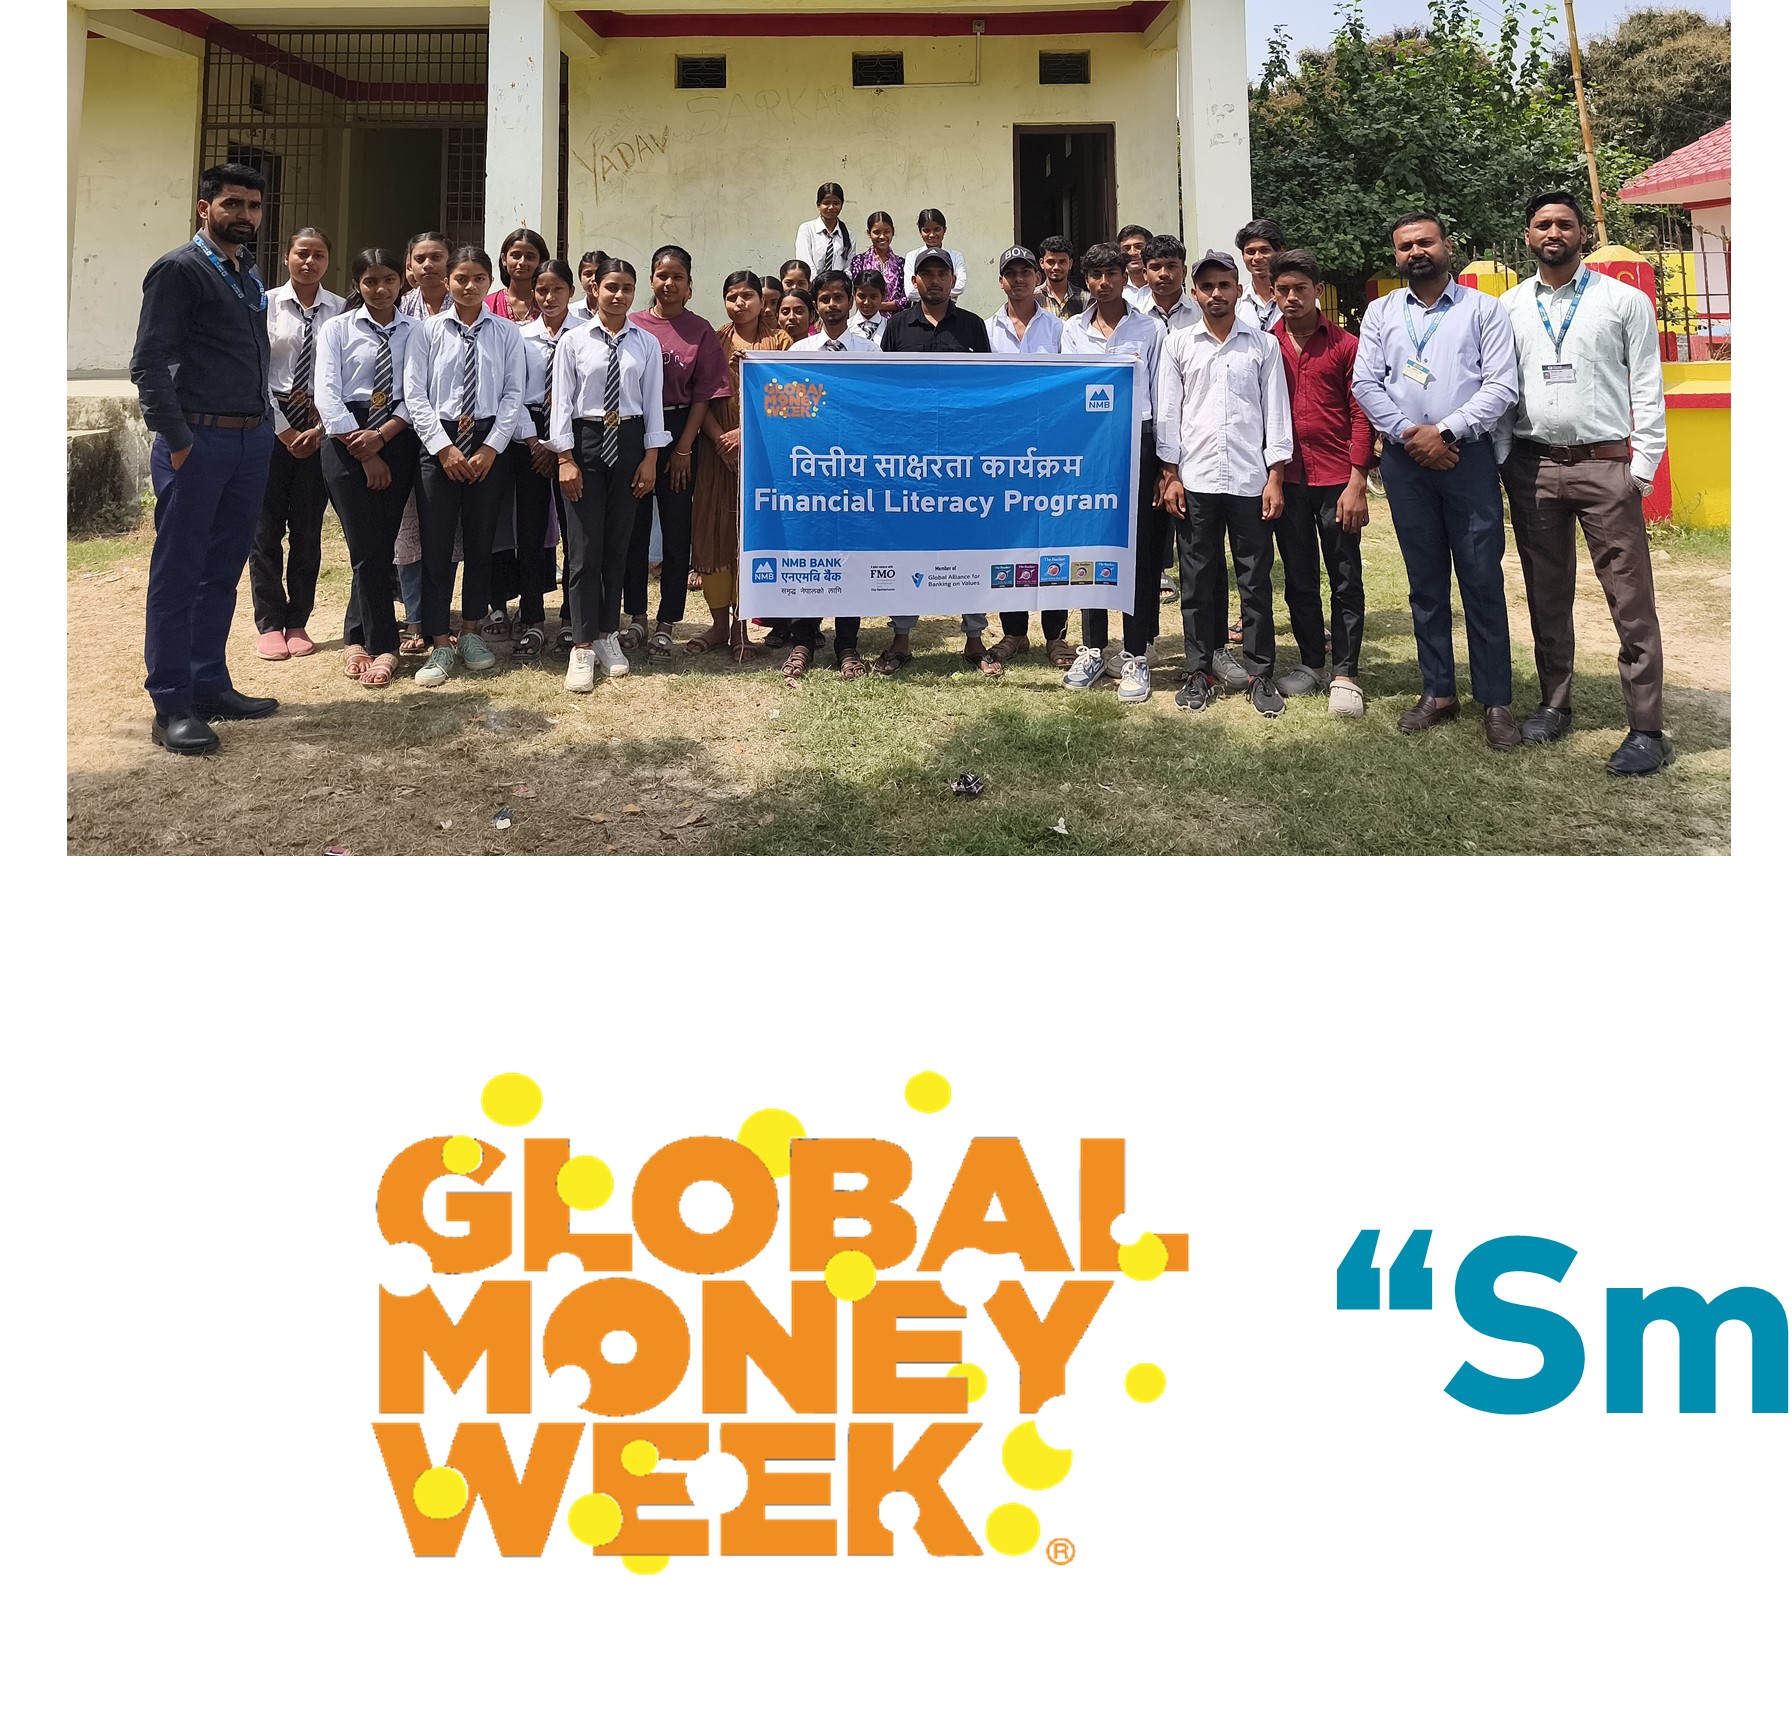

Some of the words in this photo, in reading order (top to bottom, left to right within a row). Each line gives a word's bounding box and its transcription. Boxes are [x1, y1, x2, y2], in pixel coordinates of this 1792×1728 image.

[572, 125, 670, 206] YADAV
[1004, 247, 1027, 259] BOY
[1088, 400, 1111, 410] NMB
[789, 445, 868, 478] वित्तीय
[874, 453, 974, 481] साक्षरता
[980, 447, 1084, 479] कार्यक्रम
[754, 488, 875, 513] Financial
[884, 489, 994, 518] Literacy
[1004, 489, 1119, 518] Program
[781, 558, 807, 568] NMB
[809, 558, 842, 568] BANK
[754, 572, 774, 581] NMB
[781, 569, 821, 582] एनएमबि
[823, 569, 842, 582] बैंक
[870, 569, 895, 579] FMO
